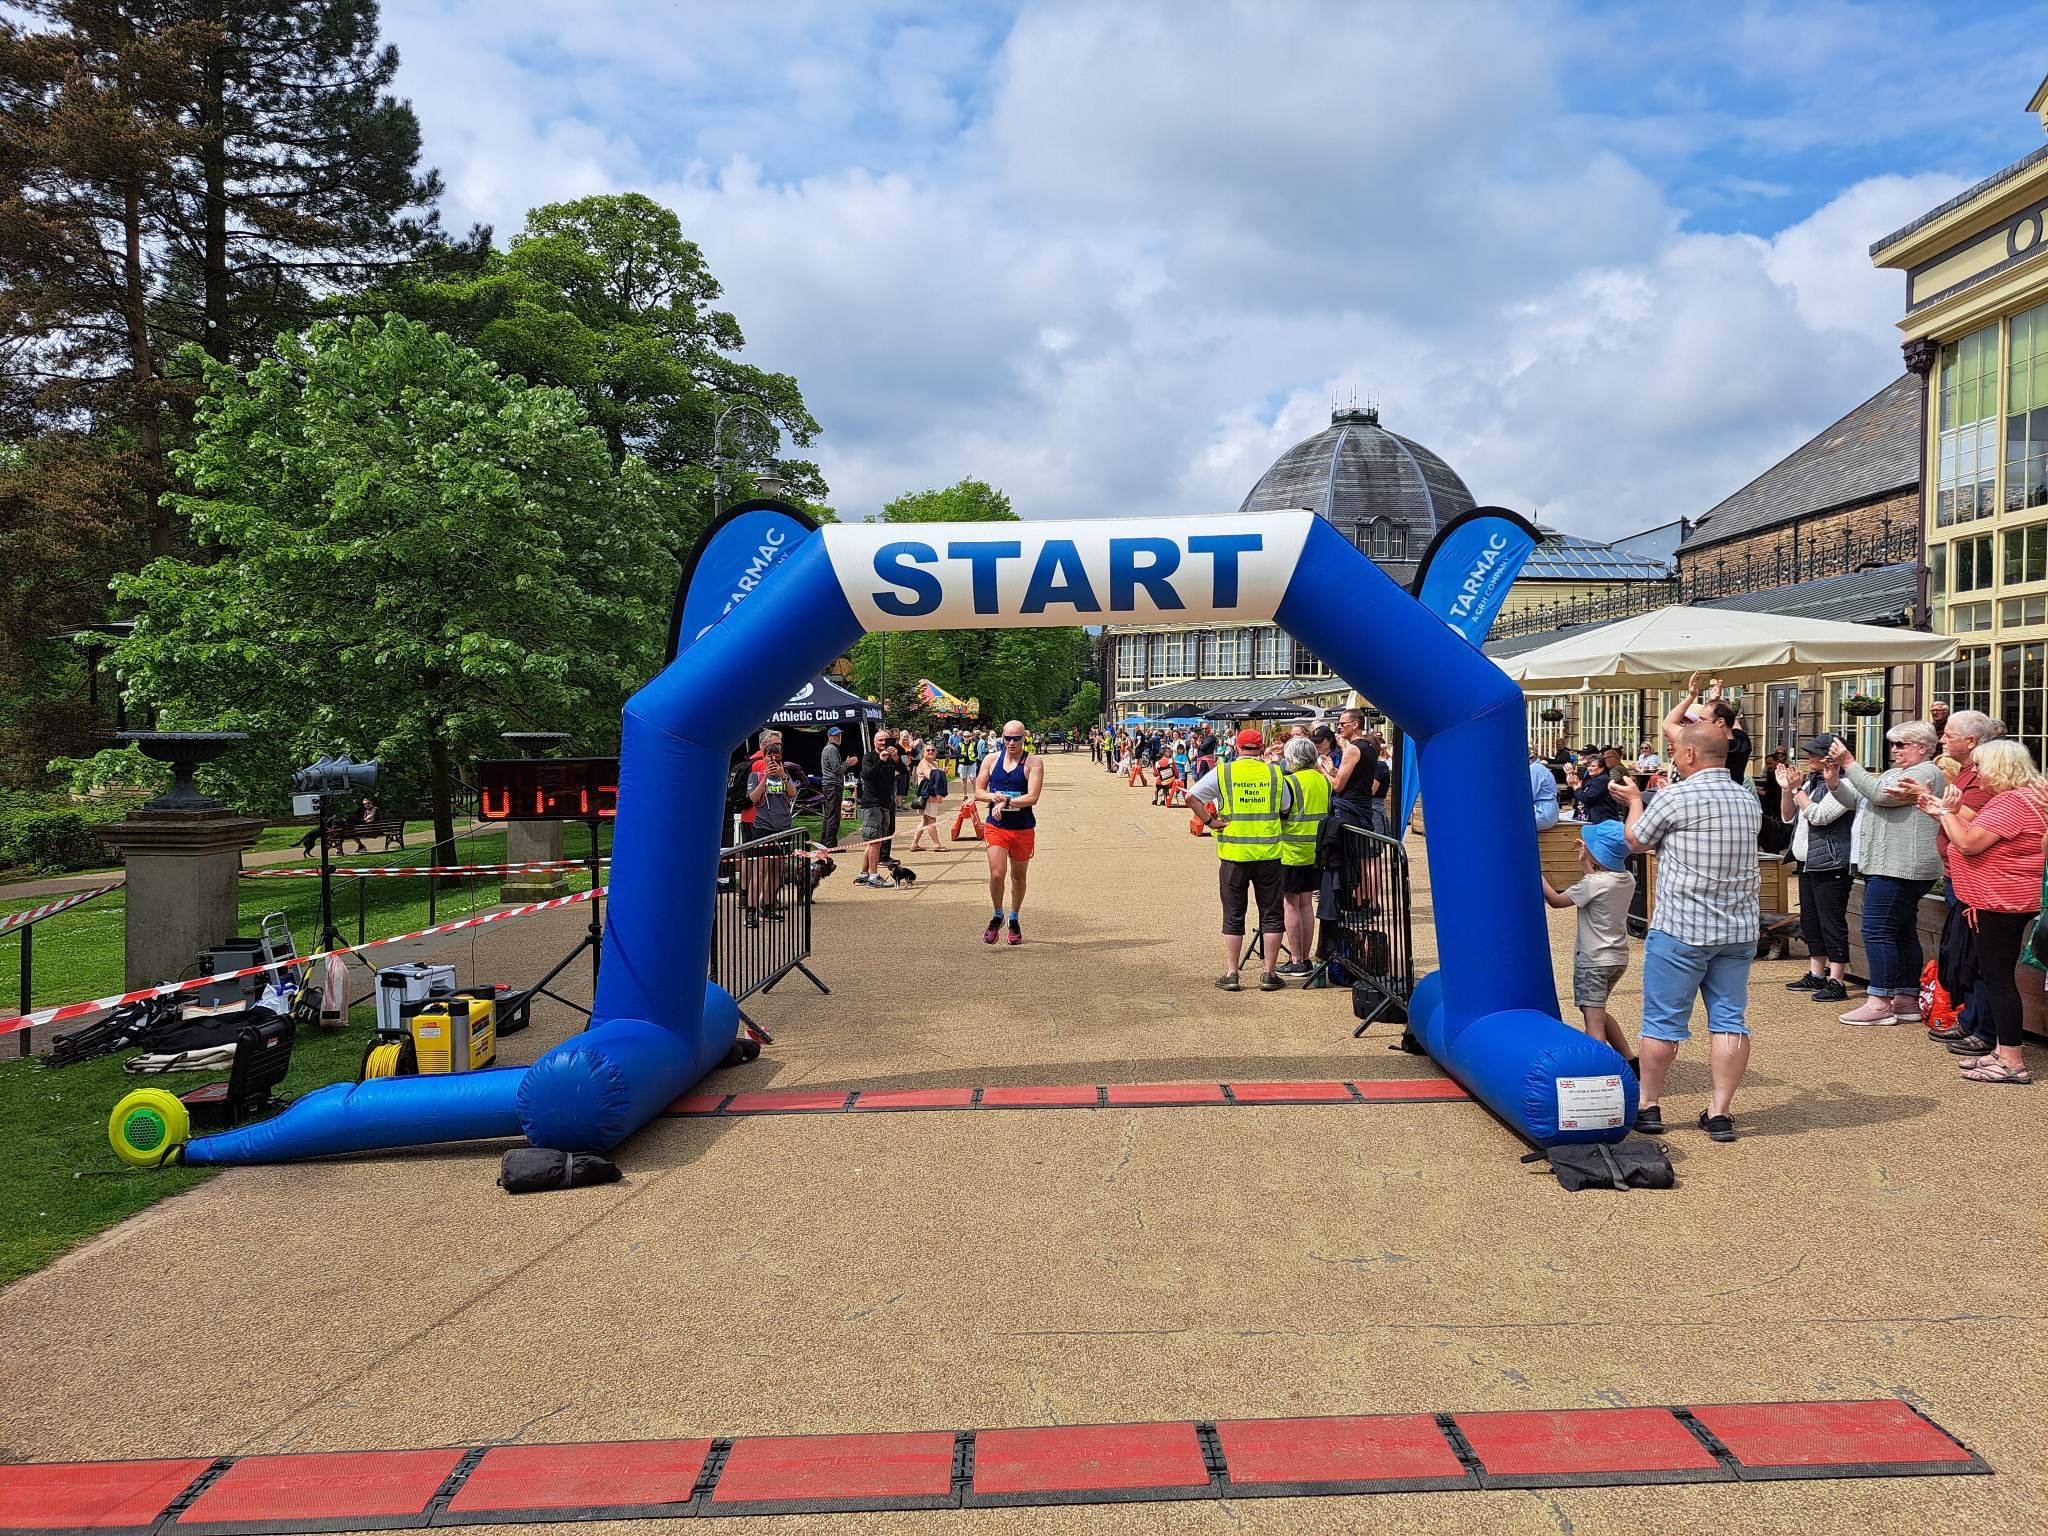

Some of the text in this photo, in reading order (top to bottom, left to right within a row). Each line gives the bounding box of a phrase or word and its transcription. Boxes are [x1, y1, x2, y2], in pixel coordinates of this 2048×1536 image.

[871, 533, 1264, 617] START
[1450, 533, 1507, 617] TARMAC
[1475, 597, 1489, 615] CRH
[1471, 616, 1480, 624] A
[772, 710, 813, 723] Athletic
[815, 708, 840, 721] Club
